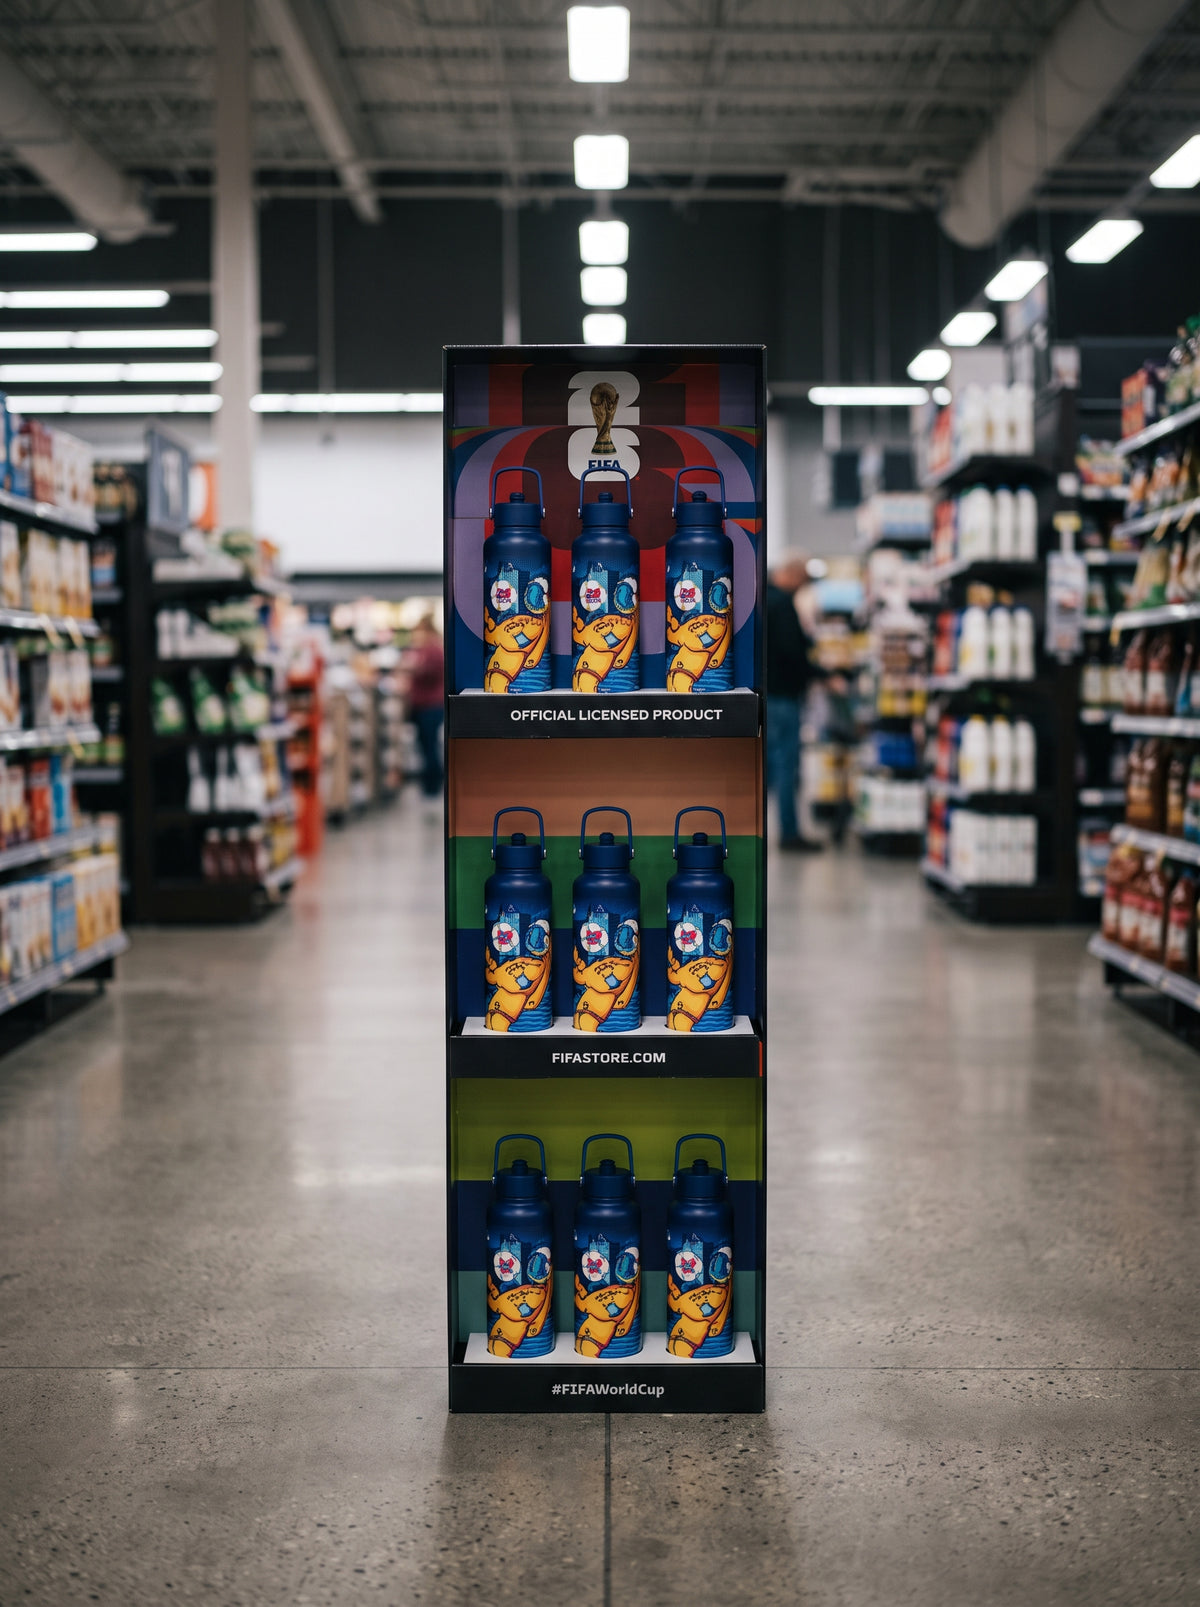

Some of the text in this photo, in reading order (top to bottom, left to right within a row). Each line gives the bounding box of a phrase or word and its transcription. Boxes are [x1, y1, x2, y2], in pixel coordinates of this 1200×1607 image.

[588, 459, 621, 472] FIFA
[510, 709, 724, 721] OFFICIAL LICENSED PRODUCT
[552, 1052, 666, 1064] FIFASTORE.COM
[551, 1383, 665, 1398] #FIFAWorldCup
